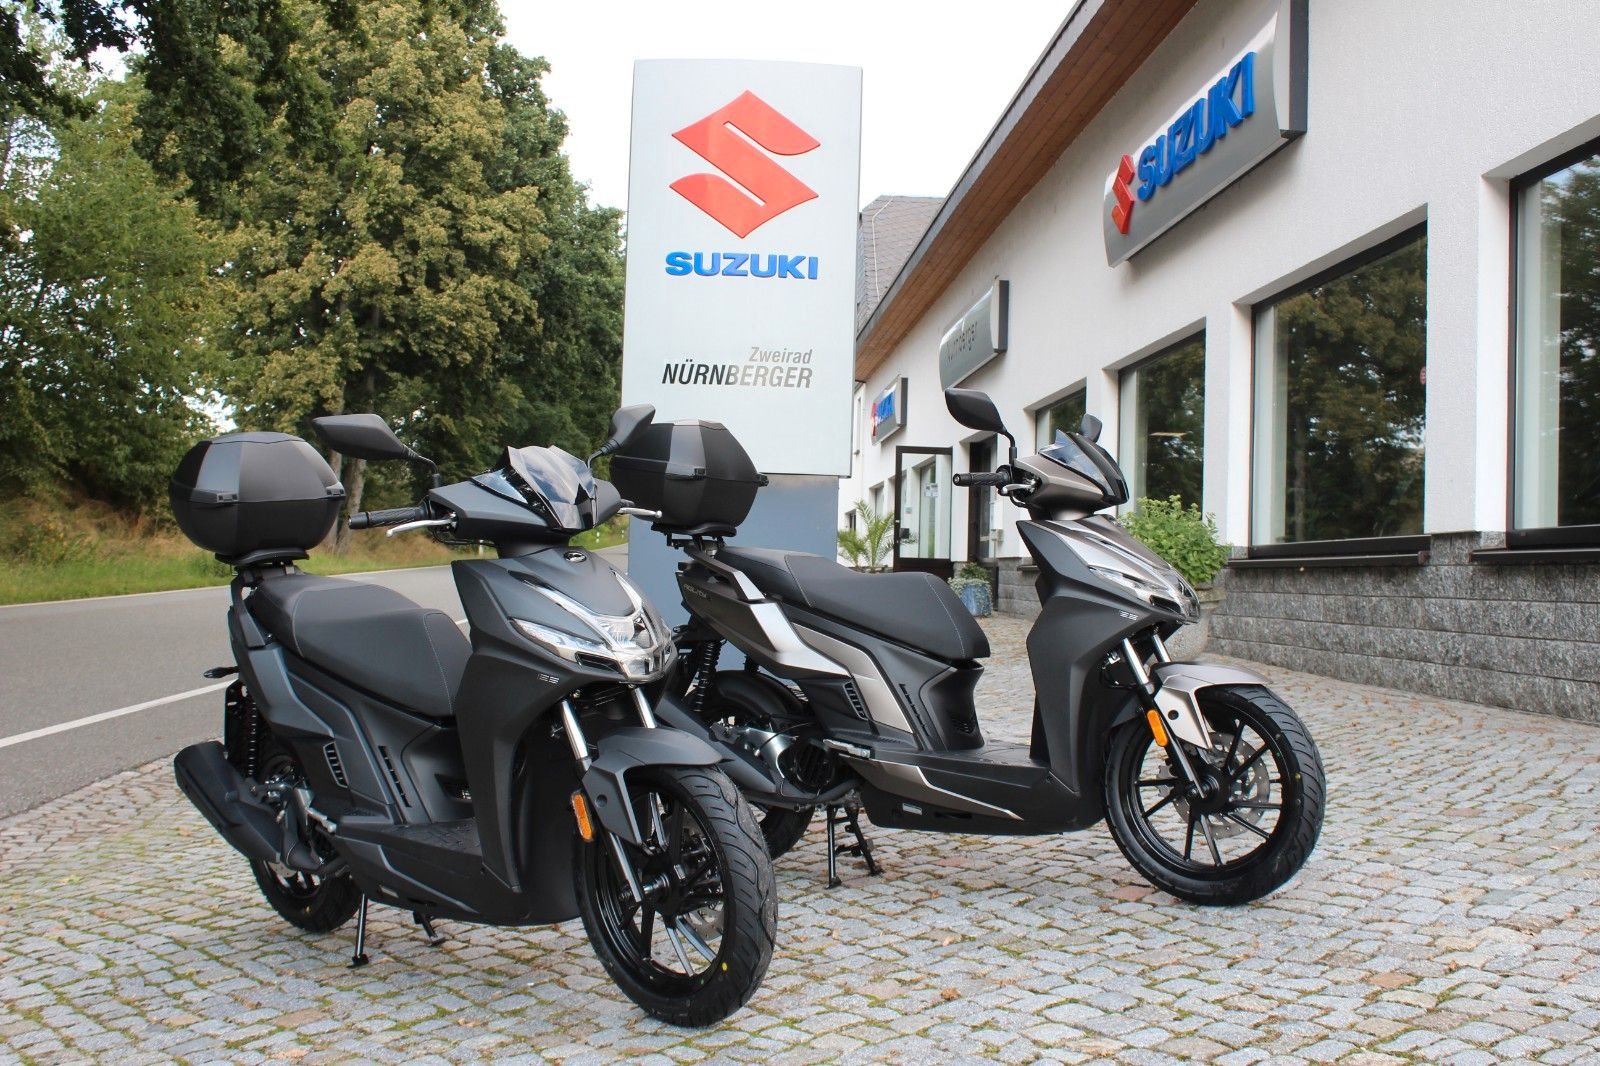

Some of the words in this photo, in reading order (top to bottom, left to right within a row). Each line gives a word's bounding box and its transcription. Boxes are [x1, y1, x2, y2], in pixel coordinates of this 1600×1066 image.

[1137, 51, 1256, 200] SUZUKI
[665, 251, 818, 280] SUZUKI
[749, 346, 813, 364] Zweirad
[661, 358, 813, 388] NÜRNBERGER
